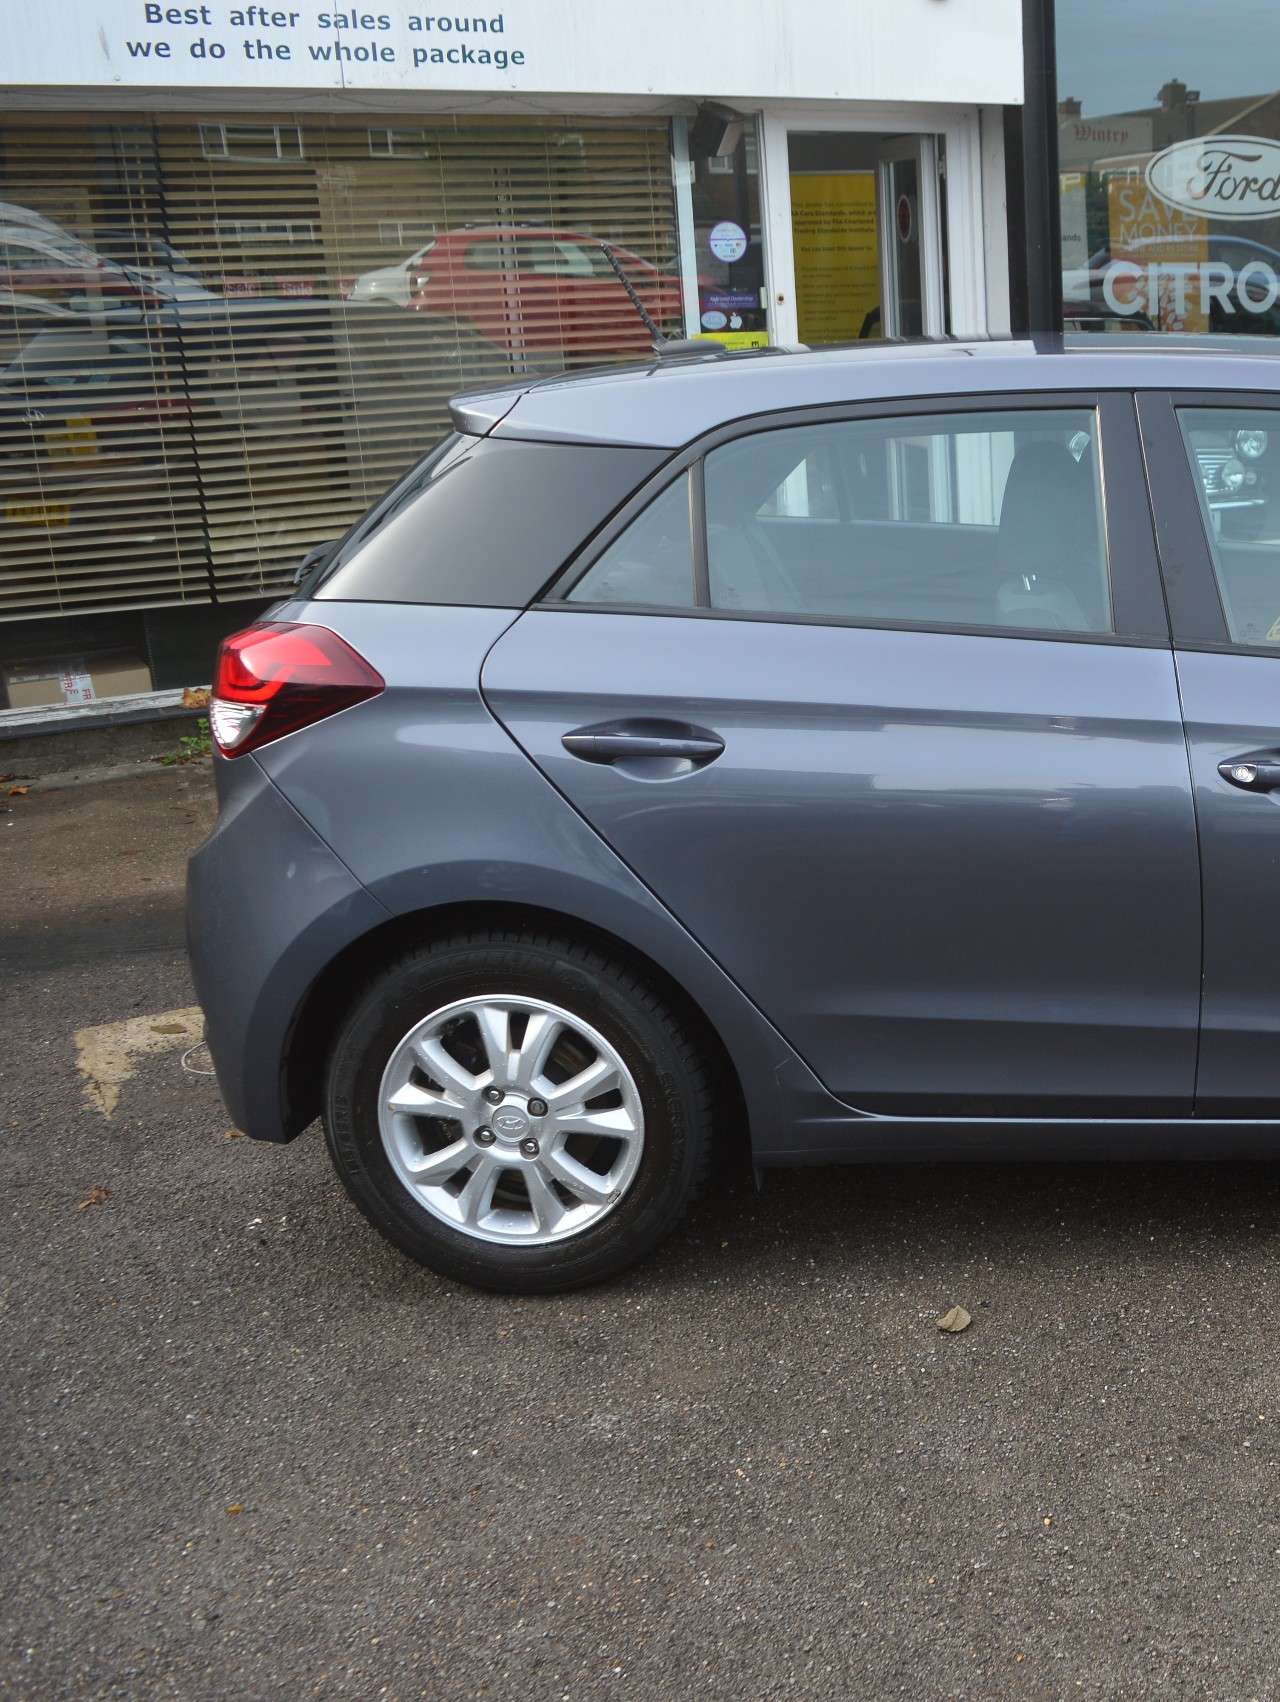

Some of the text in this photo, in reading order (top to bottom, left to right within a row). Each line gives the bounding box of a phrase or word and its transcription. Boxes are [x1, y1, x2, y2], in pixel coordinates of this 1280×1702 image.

[144, 3, 504, 34] Best after sales around
[126, 37, 525, 70] we do the whole package
[1118, 188, 1198, 222] SAV
[1118, 222, 1198, 245] MONEY
